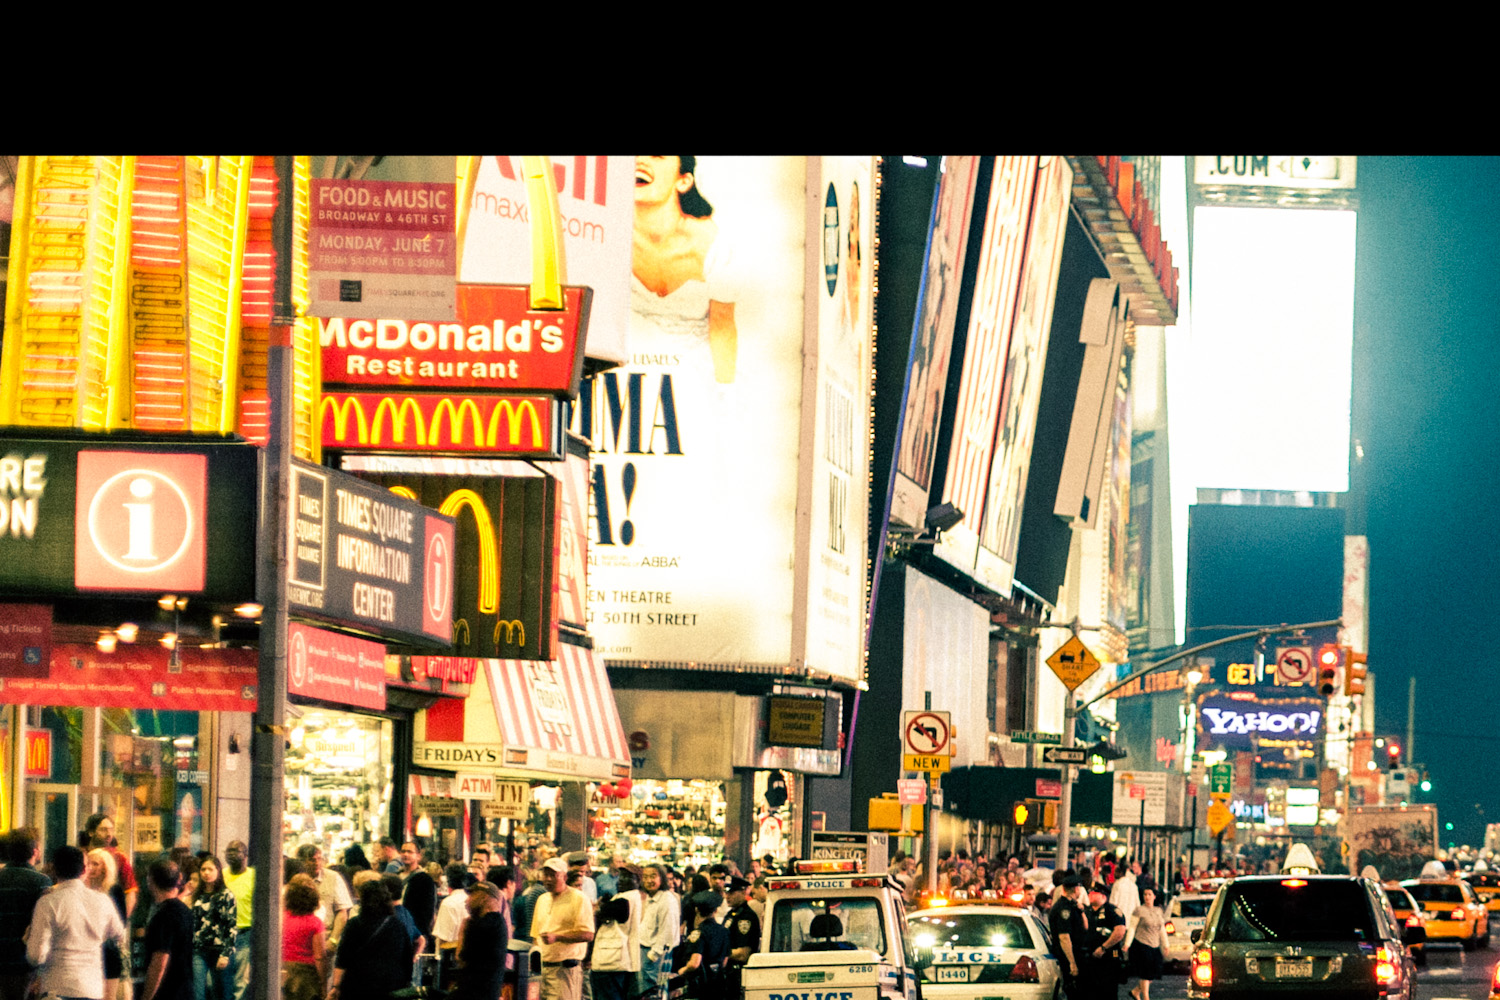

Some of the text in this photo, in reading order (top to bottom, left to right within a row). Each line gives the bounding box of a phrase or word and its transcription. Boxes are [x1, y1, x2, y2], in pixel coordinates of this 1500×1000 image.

[319, 186, 447, 210] FOOD & MUSIC
[318, 210, 446, 225] BROADWAY & 46TH ST
[319, 235, 445, 252] MONDAY, JUNE 7
[318, 255, 446, 270] FROM 5:00PM TO 8:30PM
[319, 318, 564, 353] McDonald's
[347, 355, 518, 379] Restaurant
[298, 494, 320, 518] TIMES
[336, 489, 414, 544] TIMES SQUARE
[296, 518, 322, 544] SQUARE
[337, 533, 411, 584] INFORMATION
[641, 555, 679, 568] ABBA
[353, 582, 394, 622] CENTER
[612, 591, 672, 604] THEATRE
[603, 612, 640, 624] 50TH
[647, 612, 698, 626] STREET
[11, 623, 42, 634] Tickets
[127, 661, 152, 672] Tickets
[35, 681, 57, 691] Times
[59, 683, 86, 693] Square
[171, 686, 194, 696] Public
[1202, 707, 1321, 735] YAHOO!
[425, 748, 497, 763] FRIDAY'S
[913, 757, 940, 769] NEW
[1068, 751, 1083, 760] WAY
[460, 778, 492, 793] ATM
[496, 783, 524, 804] TM
[815, 848, 863, 859] KING TUT
[807, 880, 845, 889] POLICE
[849, 965, 874, 974] 6280
[941, 970, 966, 979] 1440
